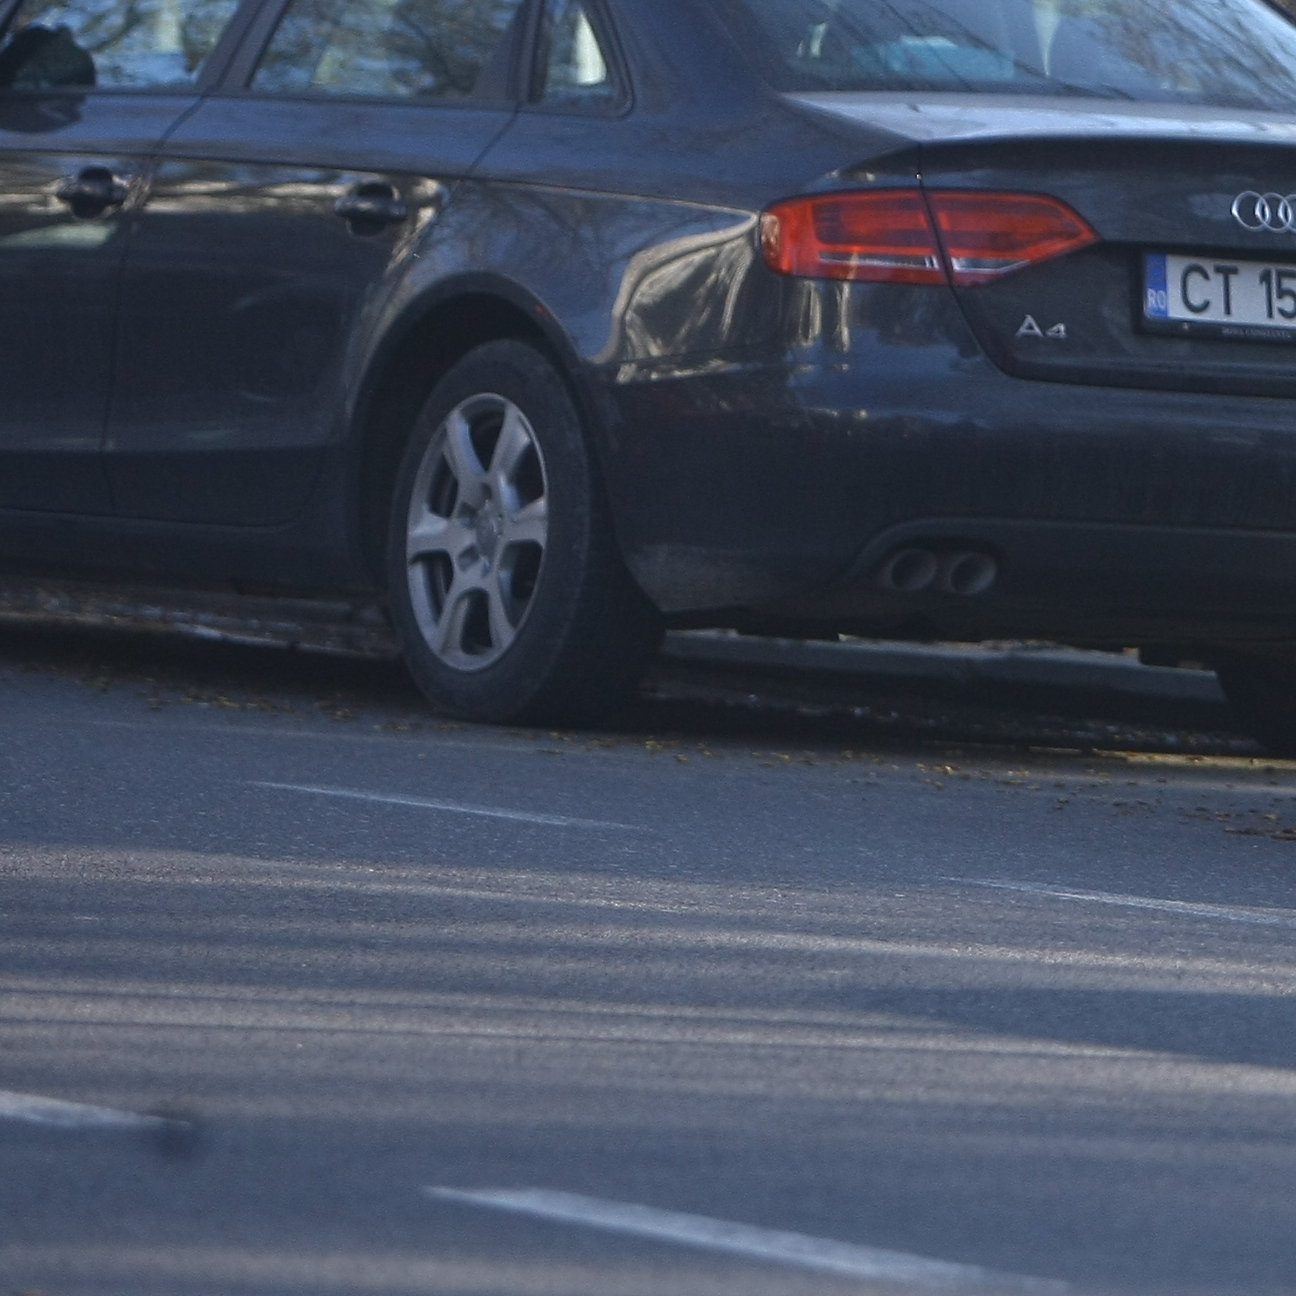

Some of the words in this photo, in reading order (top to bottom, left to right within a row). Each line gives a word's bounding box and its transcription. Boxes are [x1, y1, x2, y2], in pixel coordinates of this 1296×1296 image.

[1148, 288, 1167, 310] RO
[1180, 263, 1239, 316] CT
[1015, 314, 1068, 339] A4
